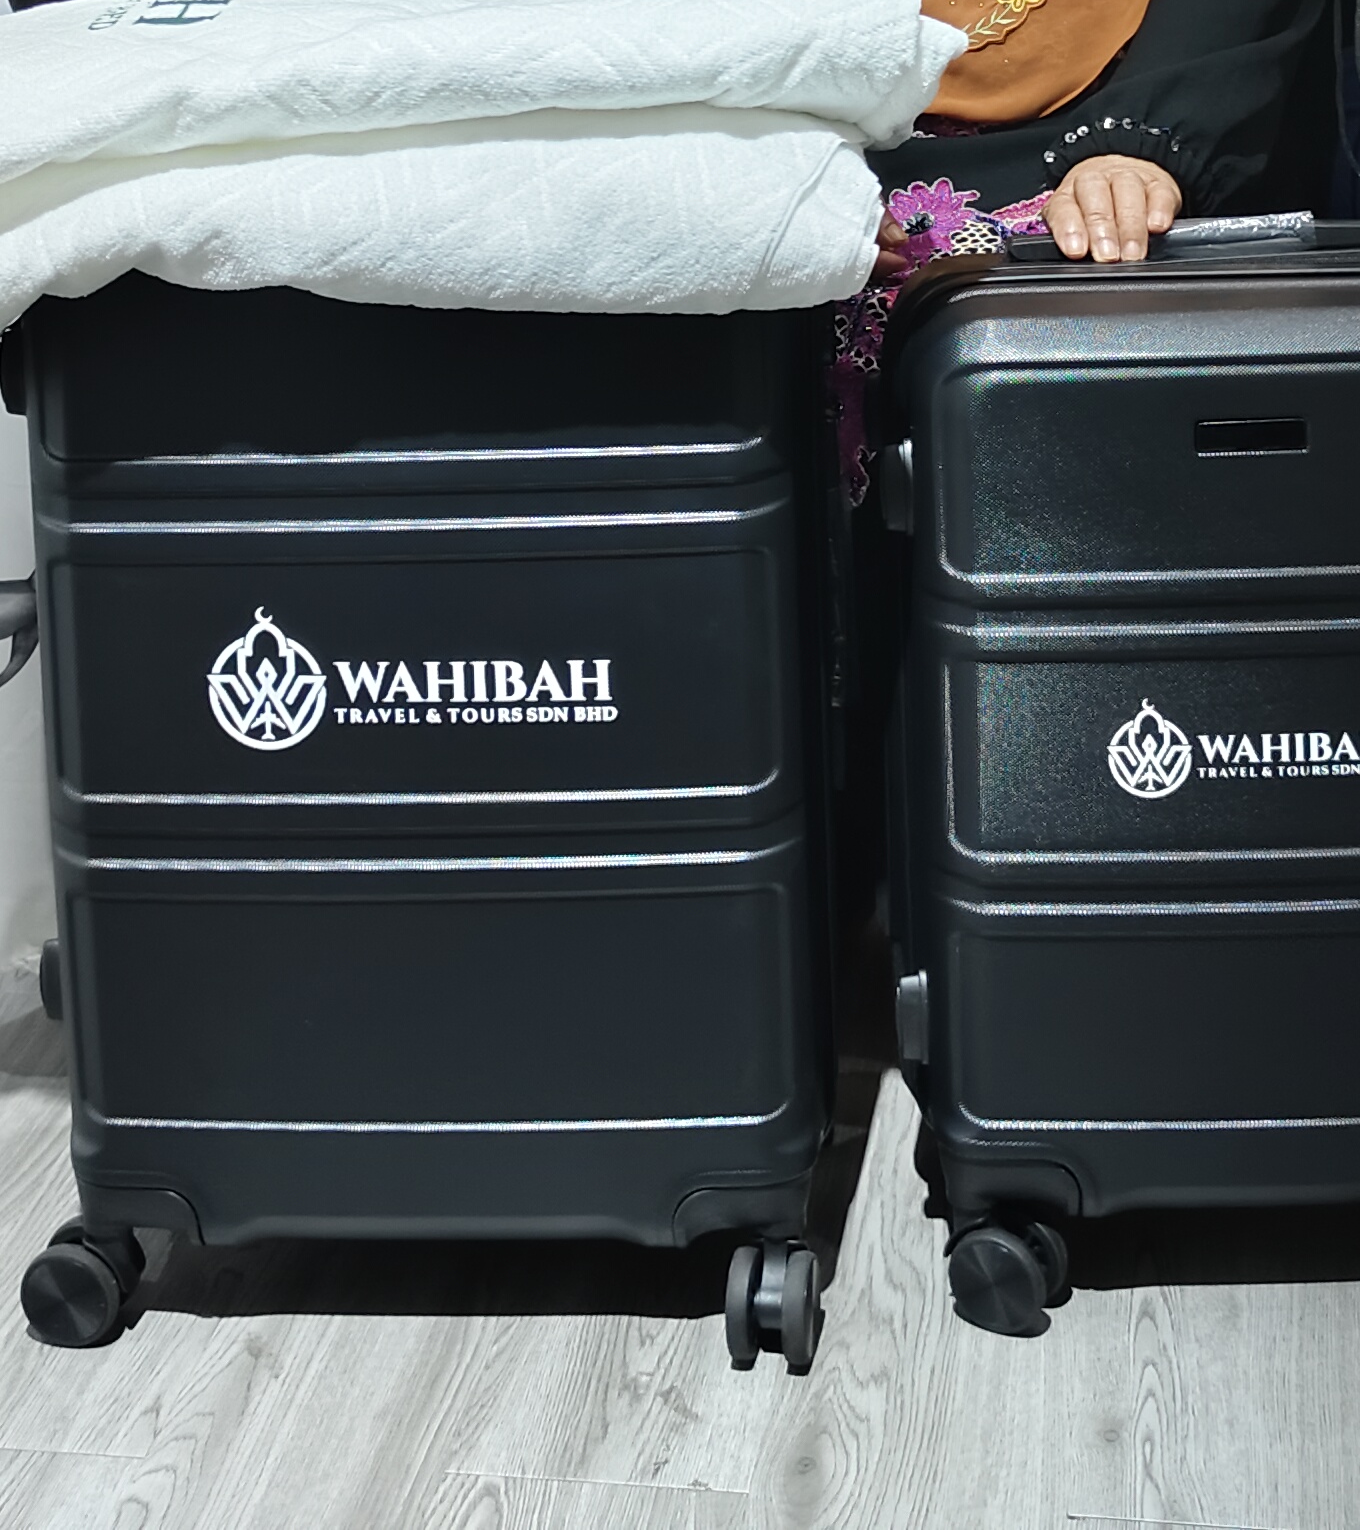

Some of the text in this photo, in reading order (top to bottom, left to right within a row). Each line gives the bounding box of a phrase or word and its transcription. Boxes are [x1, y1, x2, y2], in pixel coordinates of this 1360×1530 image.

[332, 659, 614, 704] WAHIBAH
[334, 705, 619, 724] TRAVEL & TOURS SDN BHD
[1196, 766, 1258, 780] TRAVEL
[1261, 766, 1273, 779] &
[1278, 764, 1330, 778] TOURS
